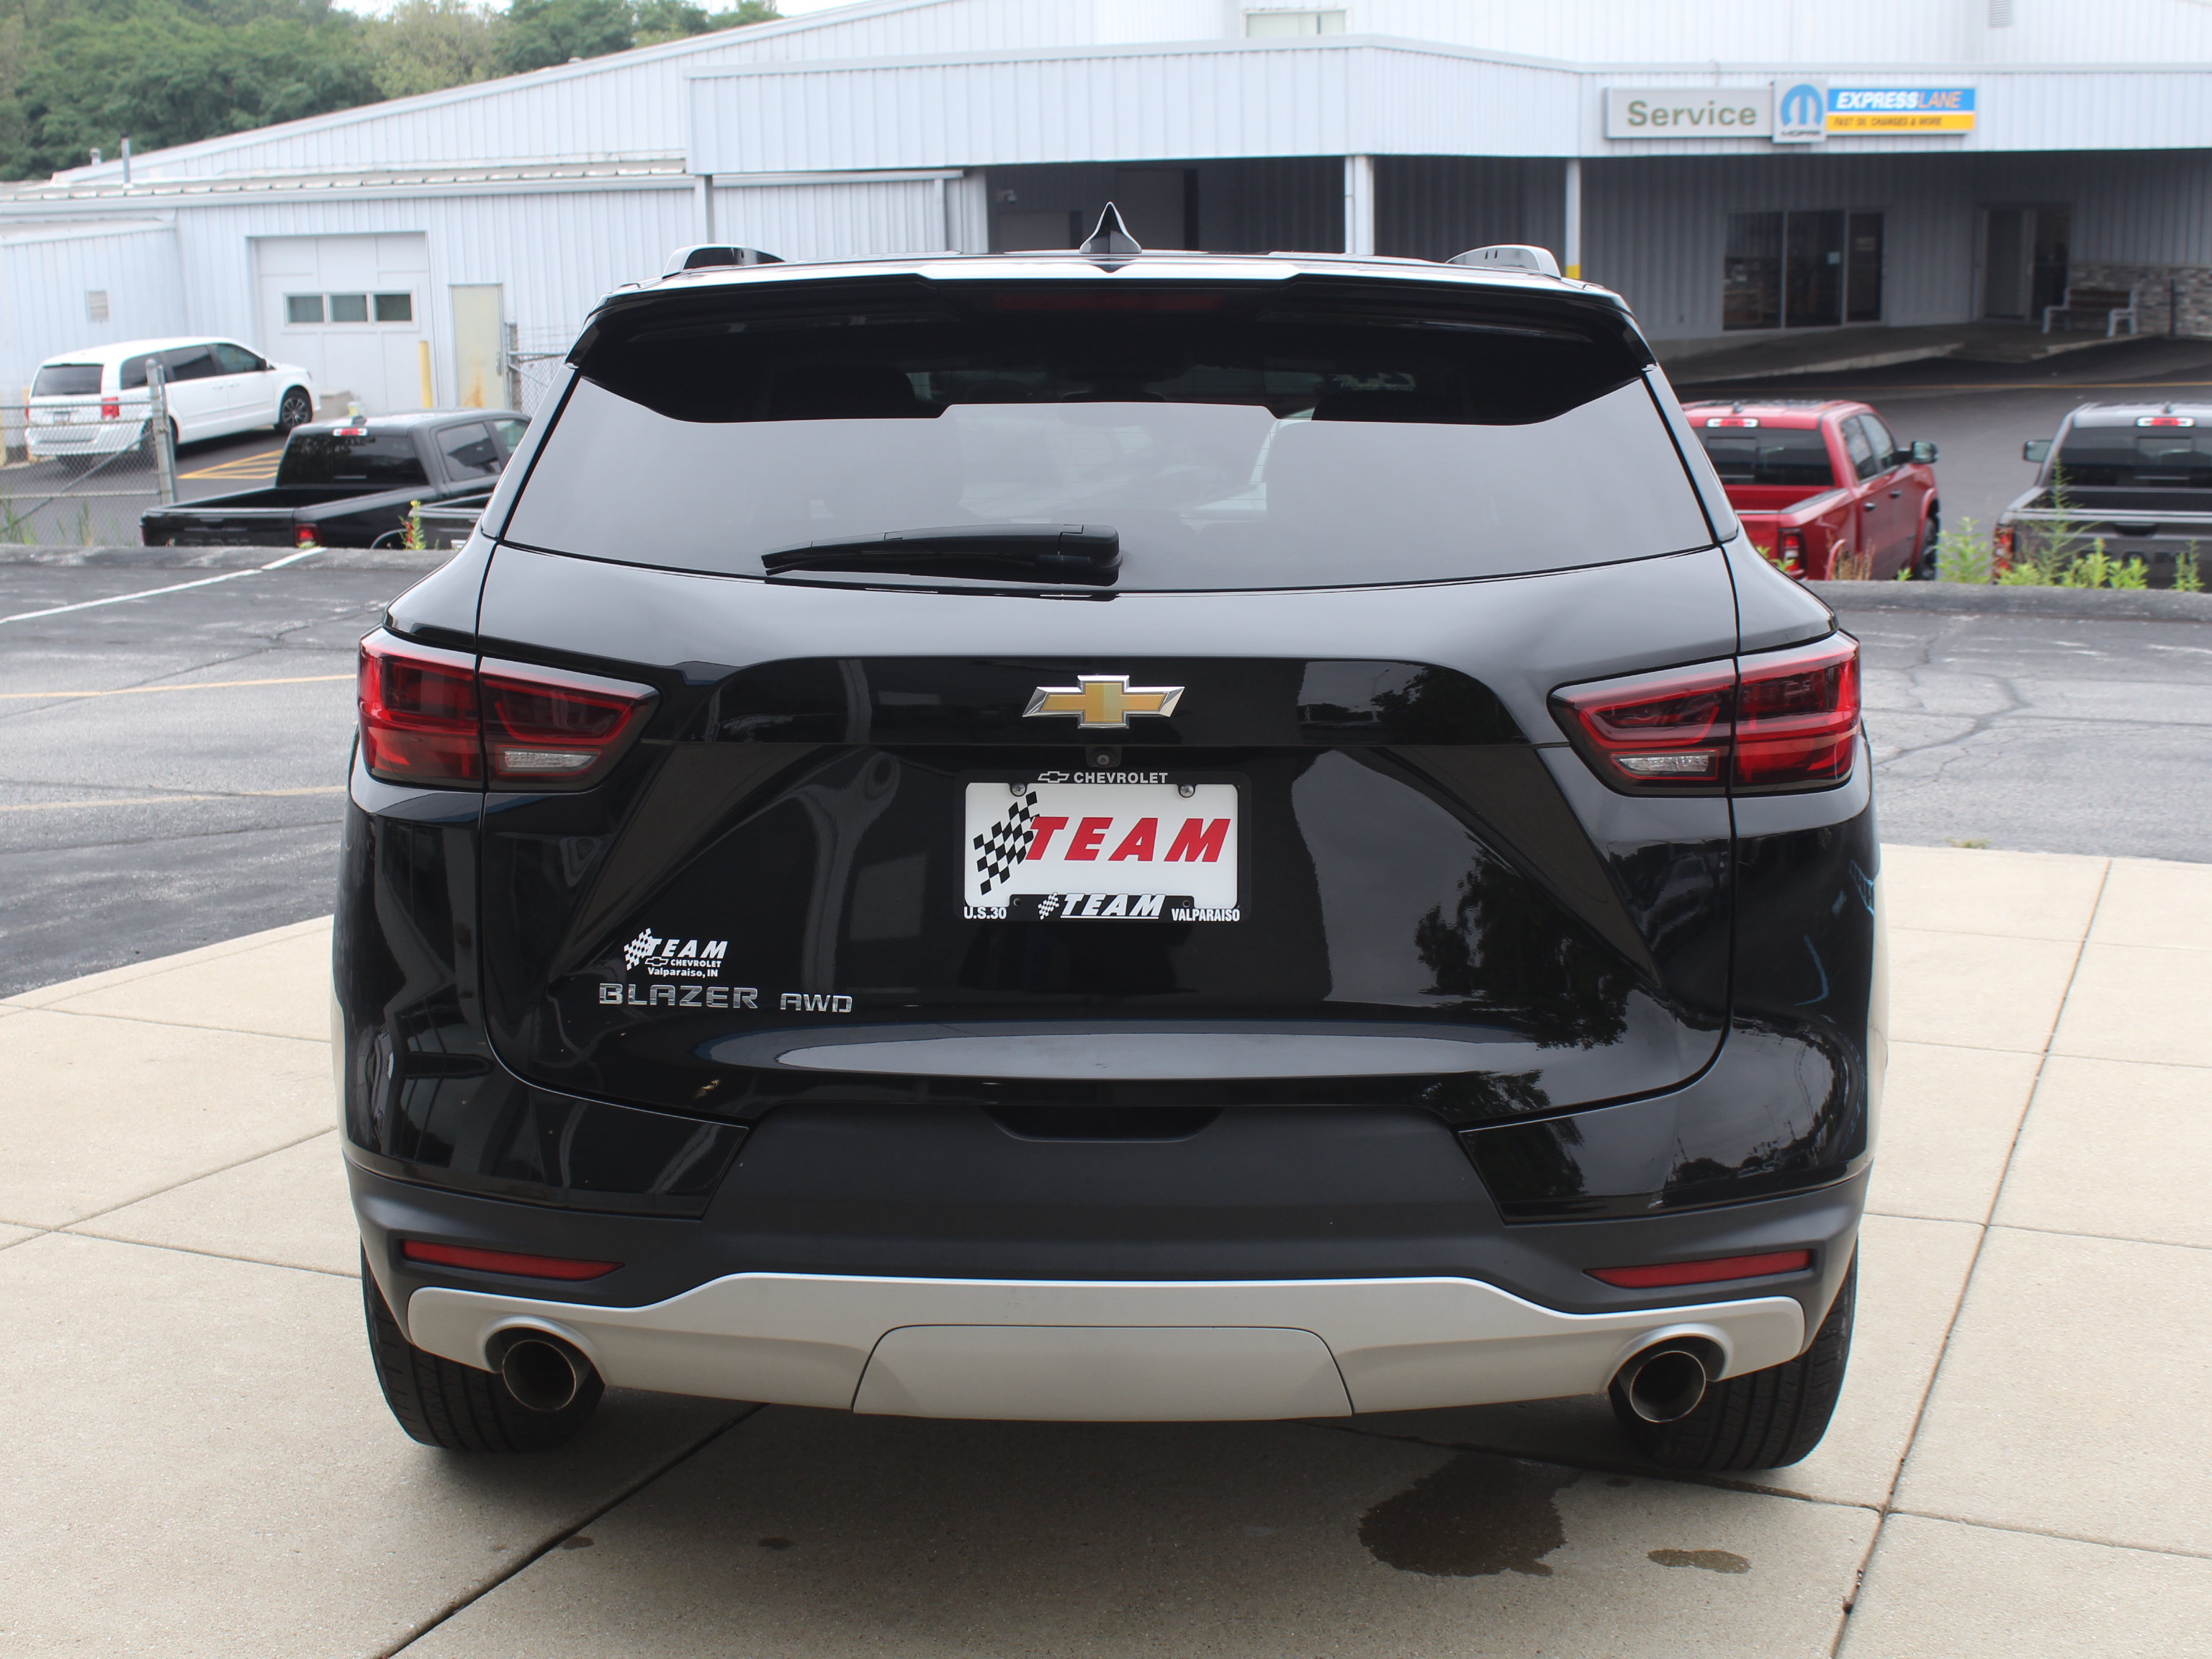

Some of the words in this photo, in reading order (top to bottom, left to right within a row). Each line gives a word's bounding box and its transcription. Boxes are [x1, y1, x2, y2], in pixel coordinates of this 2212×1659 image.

[1627, 100, 1757, 127] Service
[1871, 117, 1908, 126] CHANGES
[1073, 772, 1168, 784] CHEVROLET
[1025, 816, 1231, 863] TEAM
[1060, 893, 1166, 917] TEAM
[1171, 908, 1241, 922] VALPARAISO
[646, 938, 728, 959] TEAM
[670, 958, 721, 968] CHEVROLET
[647, 967, 706, 979] Valparaiso,
[706, 968, 719, 978] IN
[599, 983, 758, 1010] BLAZER
[780, 992, 853, 1013] AWD
